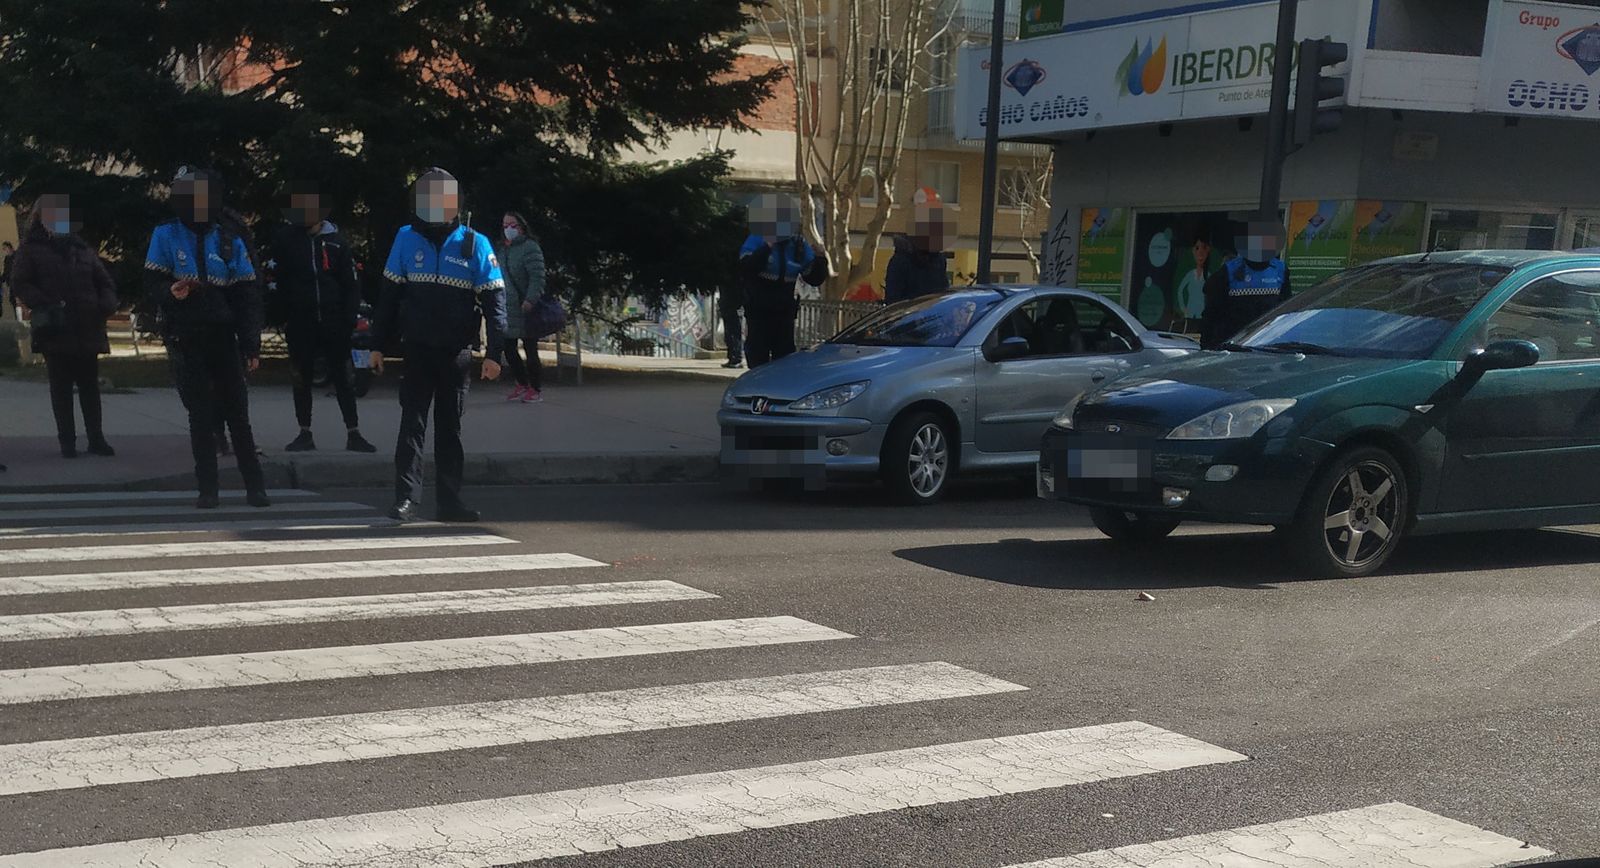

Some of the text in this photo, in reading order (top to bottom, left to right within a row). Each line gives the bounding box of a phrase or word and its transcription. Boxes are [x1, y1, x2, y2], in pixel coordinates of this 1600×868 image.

[1519, 10, 1560, 30] Grupo
[1218, 92, 1242, 103] Punto
[1243, 90, 1254, 100] de
[1508, 79, 1589, 111] OCHO
[979, 95, 1089, 127] OHO CAÑOS
